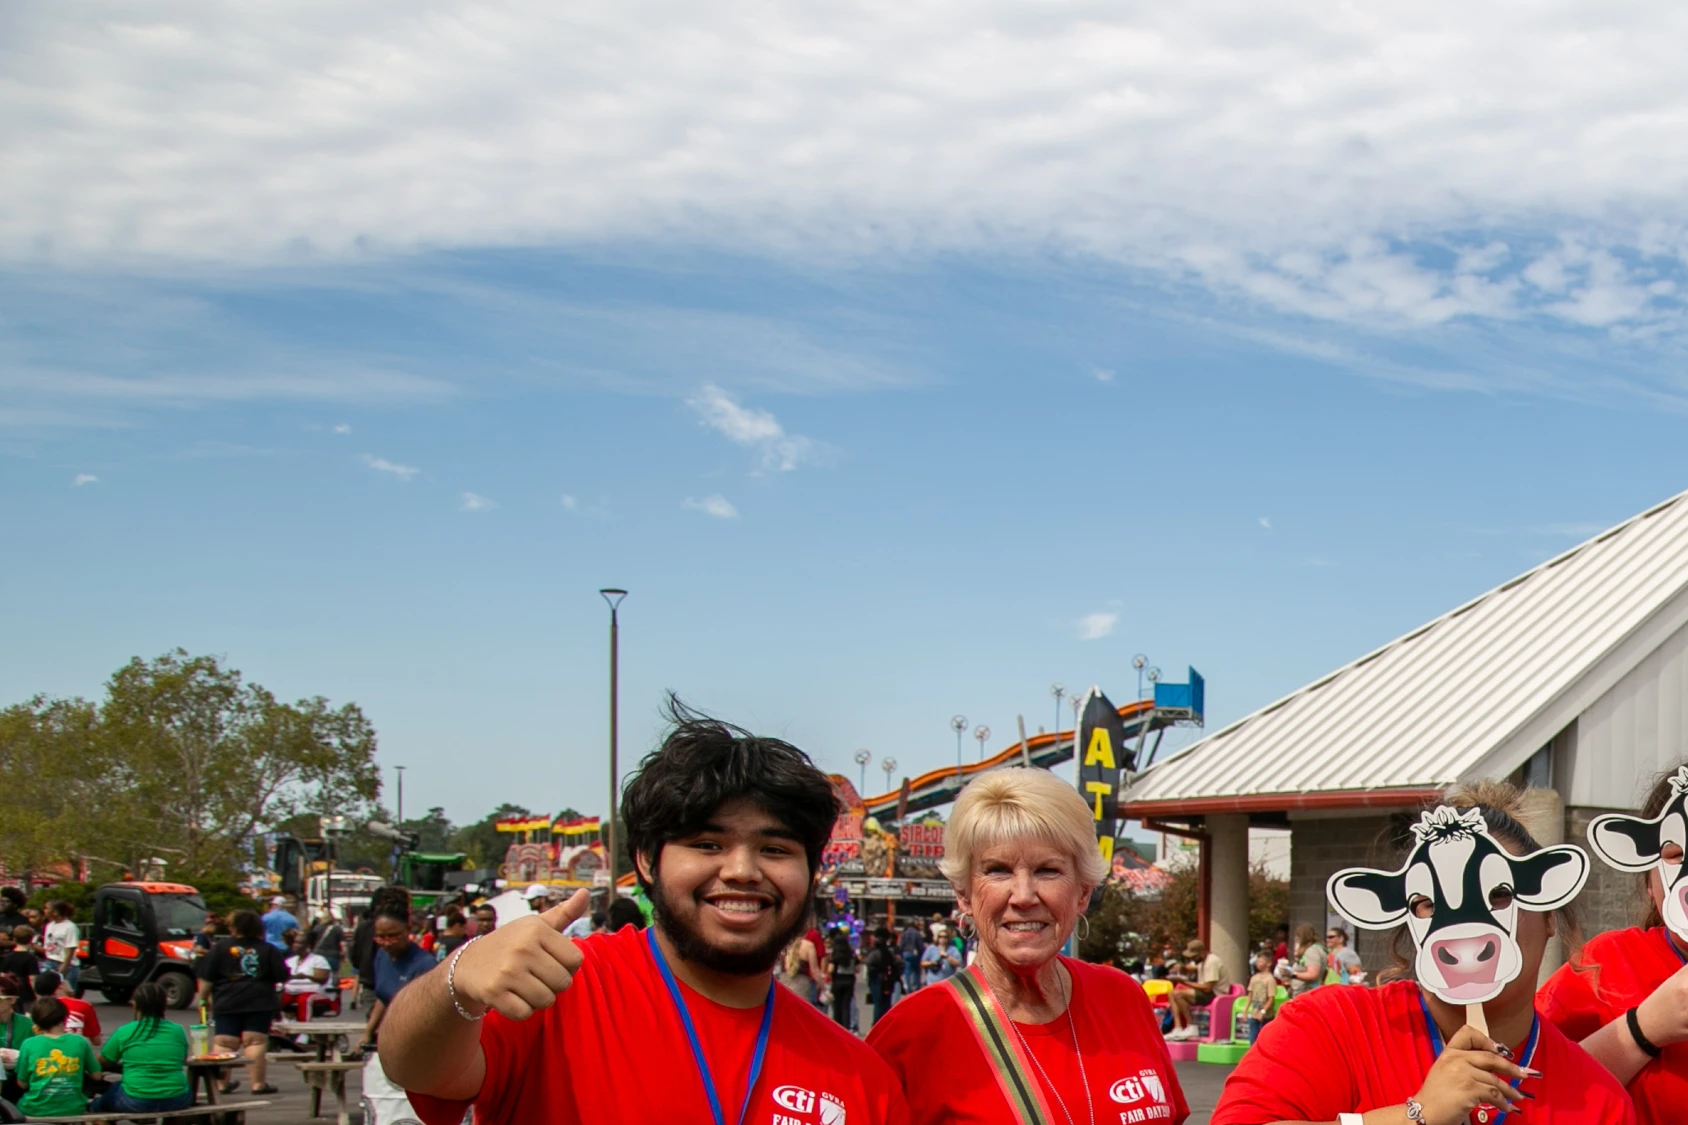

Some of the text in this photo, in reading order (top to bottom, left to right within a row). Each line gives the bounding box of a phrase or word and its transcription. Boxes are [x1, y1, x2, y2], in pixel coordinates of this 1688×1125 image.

[821, 1091, 846, 1107] GVRA
[1113, 1076, 1145, 1102] cti
[778, 1089, 815, 1113] cti
[1119, 1108, 1146, 1125] FAIR
[1145, 1105, 1163, 1120] DAY
